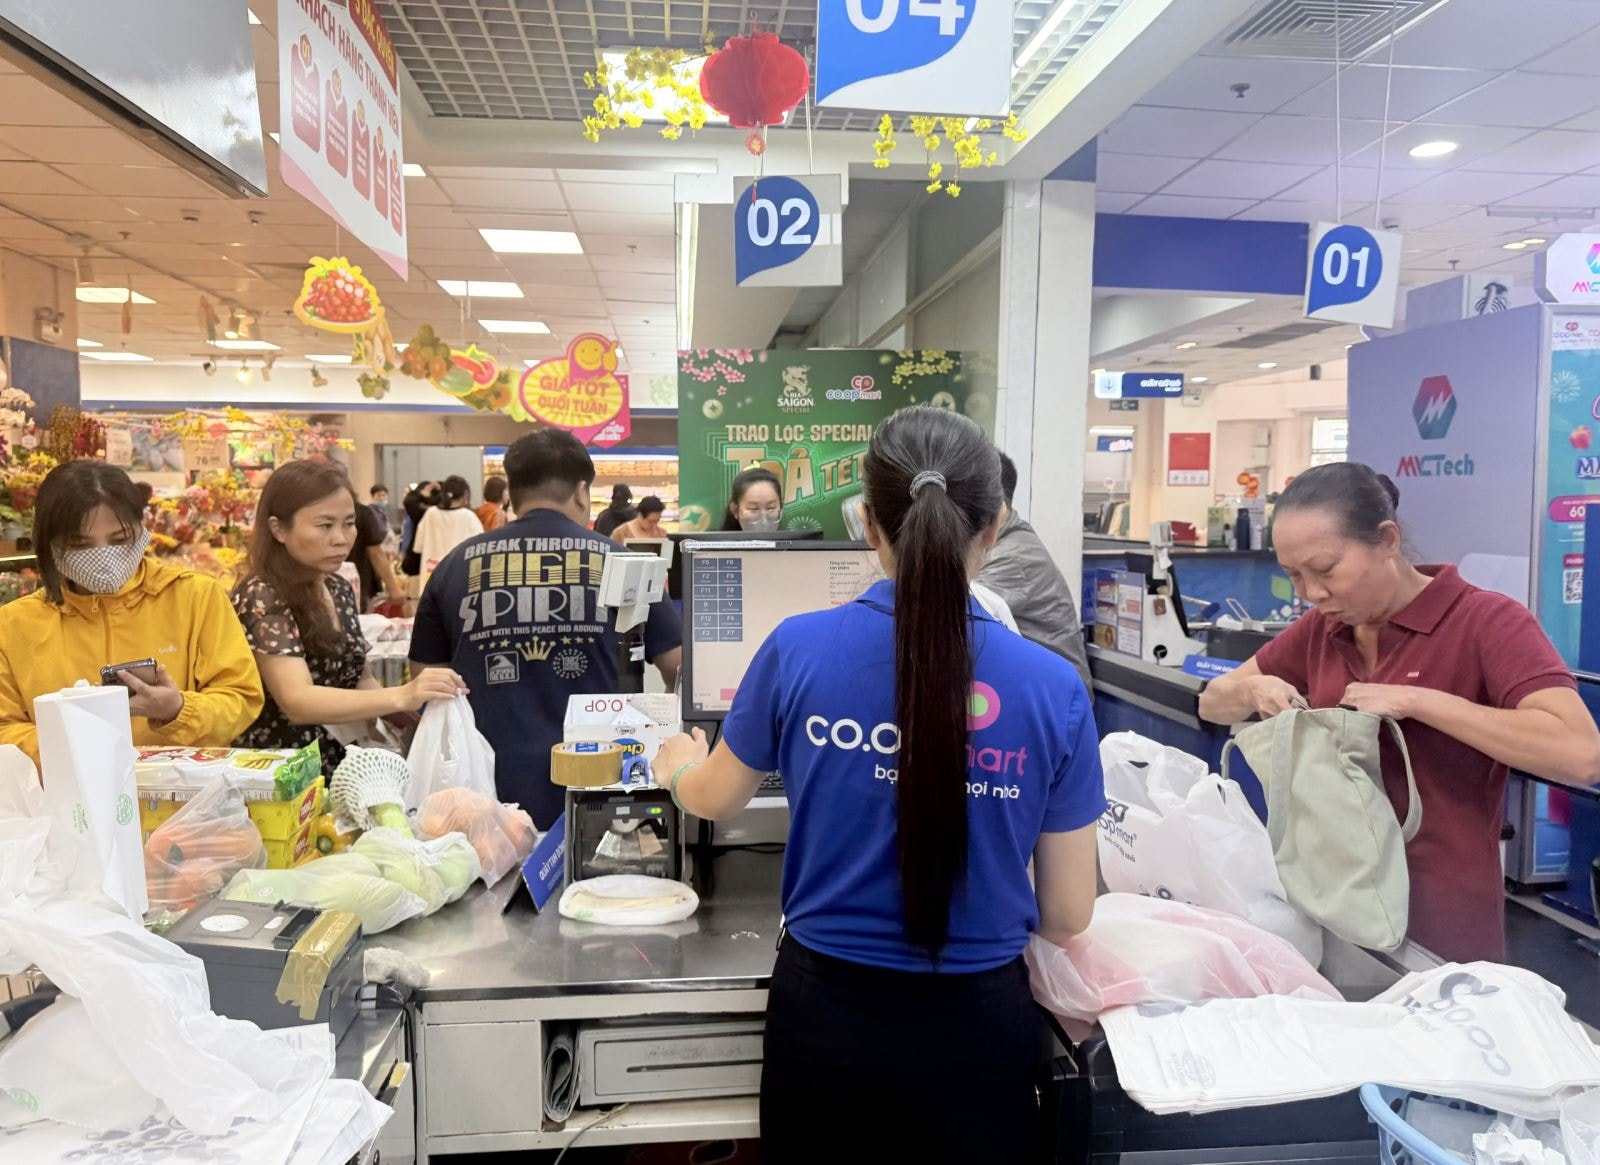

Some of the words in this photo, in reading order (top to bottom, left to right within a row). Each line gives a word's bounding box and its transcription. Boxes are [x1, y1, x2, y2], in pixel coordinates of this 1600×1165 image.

[746, 197, 812, 247] 02
[1321, 242, 1370, 288] 01
[777, 397, 814, 407] SAIGON
[725, 424, 770, 442] TRAO
[775, 424, 804, 445] LỘC
[464, 538, 522, 560] BREAK
[525, 537, 611, 553] THROUGH
[468, 551, 604, 593] HIGH
[492, 627, 511, 637] WITH
[512, 626, 531, 635] THIS
[532, 625, 556, 633] PEACE
[584, 699, 623, 713] O.OP
[993, 785, 1020, 800] nhà
